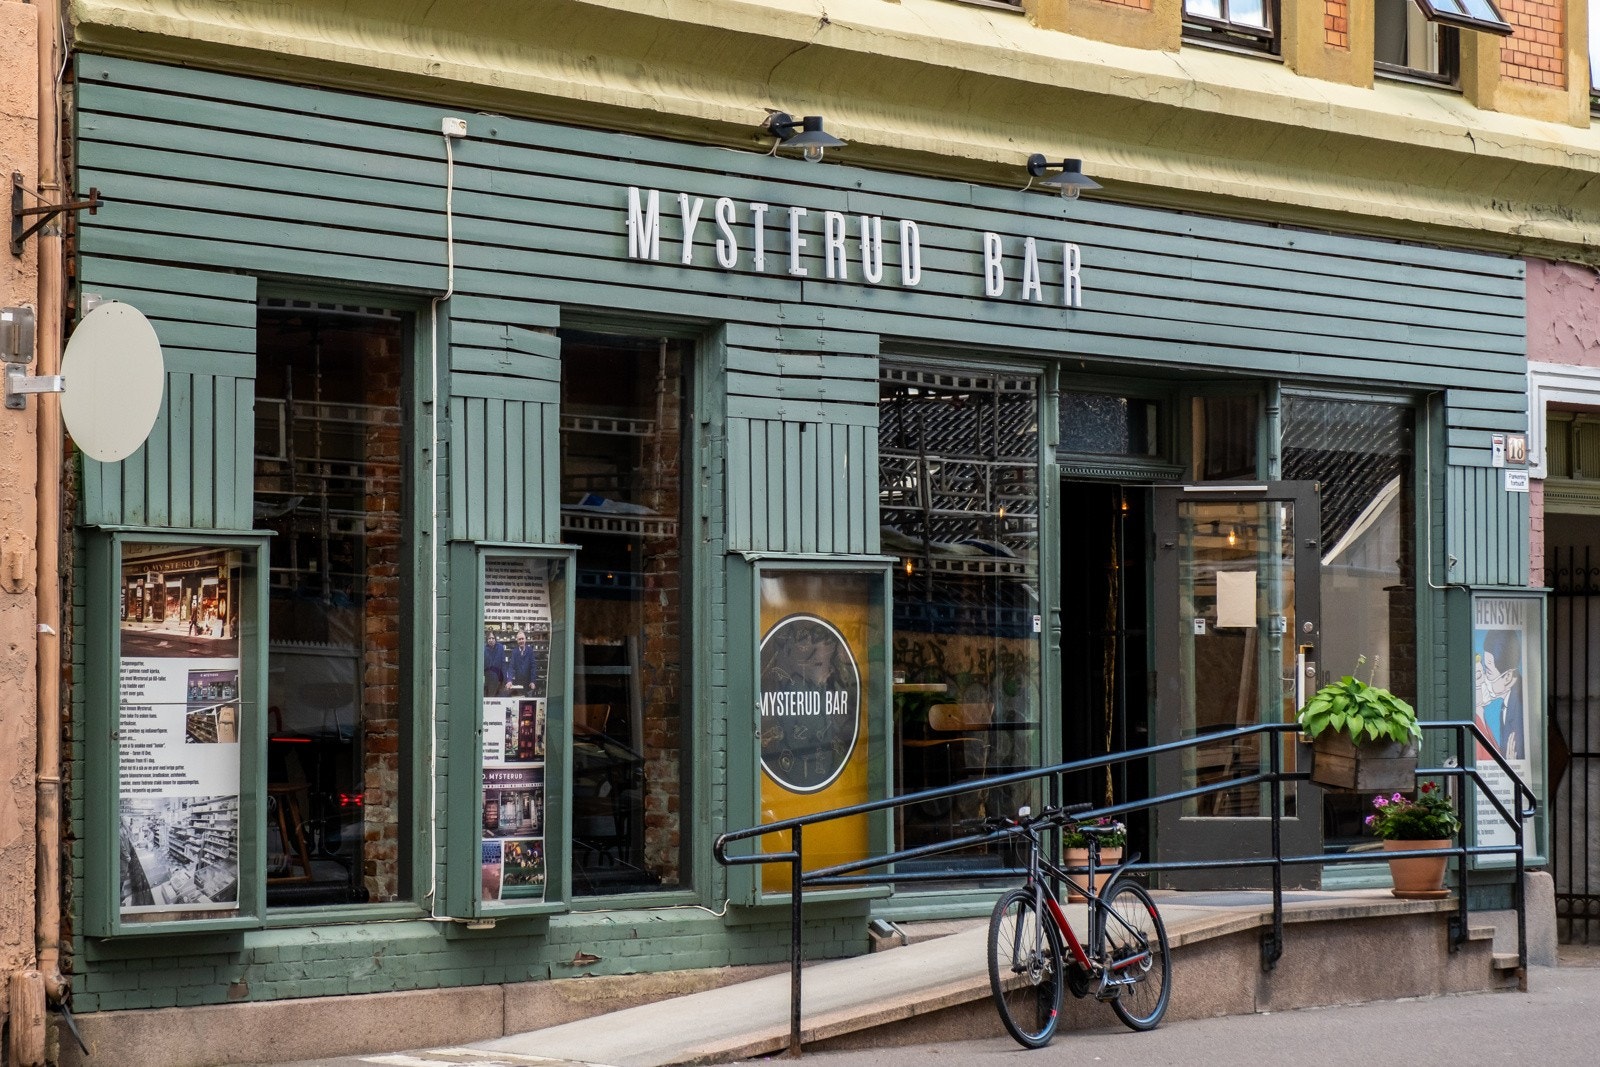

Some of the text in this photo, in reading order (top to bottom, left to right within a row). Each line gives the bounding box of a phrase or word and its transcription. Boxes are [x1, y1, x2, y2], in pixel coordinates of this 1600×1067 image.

[625, 187, 1082, 307] MYSTERUD BAR
[760, 691, 848, 716] MYSTERUD BAR
